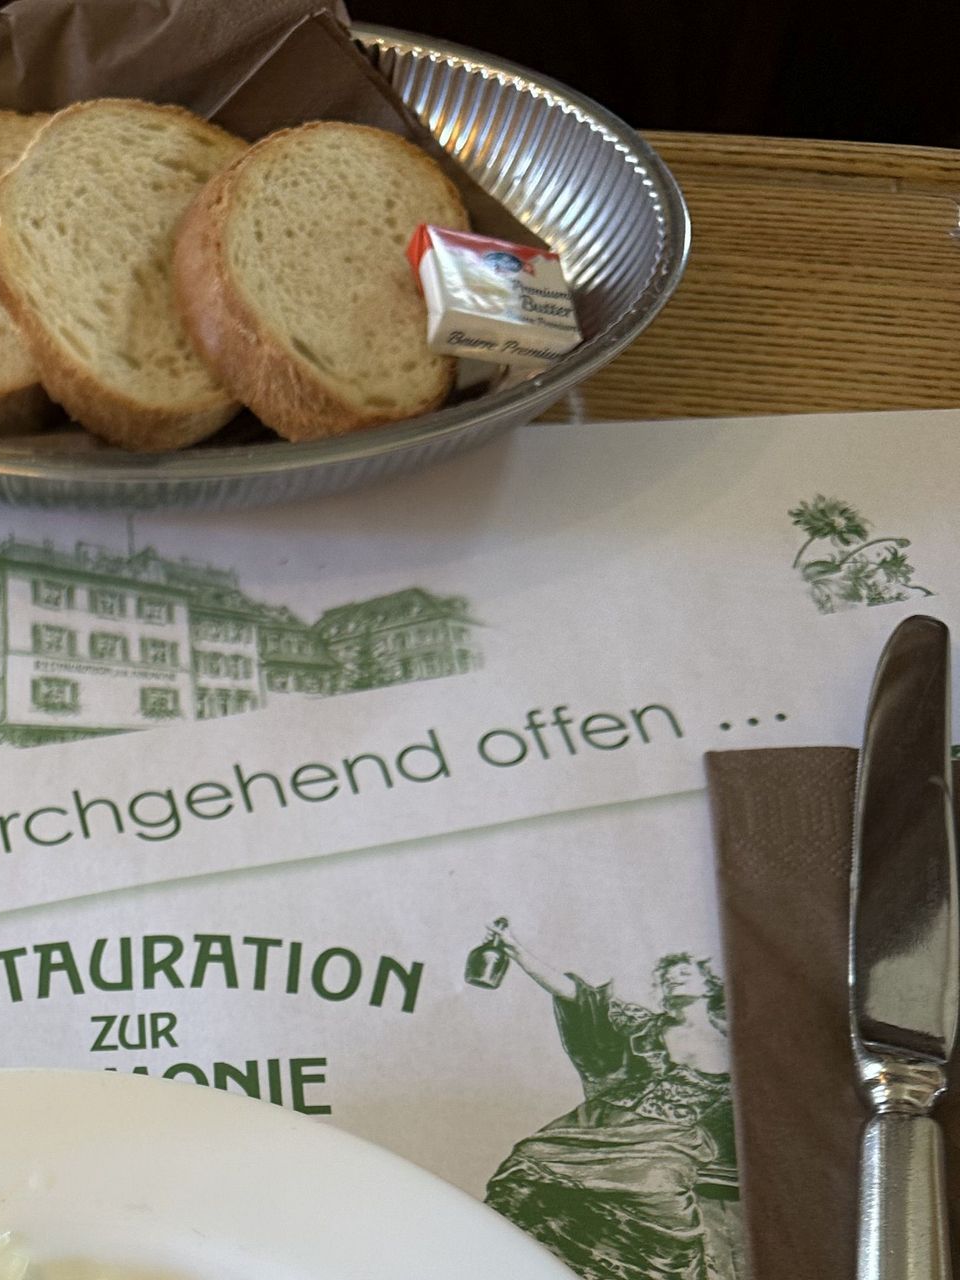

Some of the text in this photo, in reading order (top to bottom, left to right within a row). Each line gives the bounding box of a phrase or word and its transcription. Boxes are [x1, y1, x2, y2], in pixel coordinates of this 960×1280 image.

[521, 294, 574, 317] Butter
[477, 703, 684, 768] offen
[89, 1011, 179, 1053] ZUR
